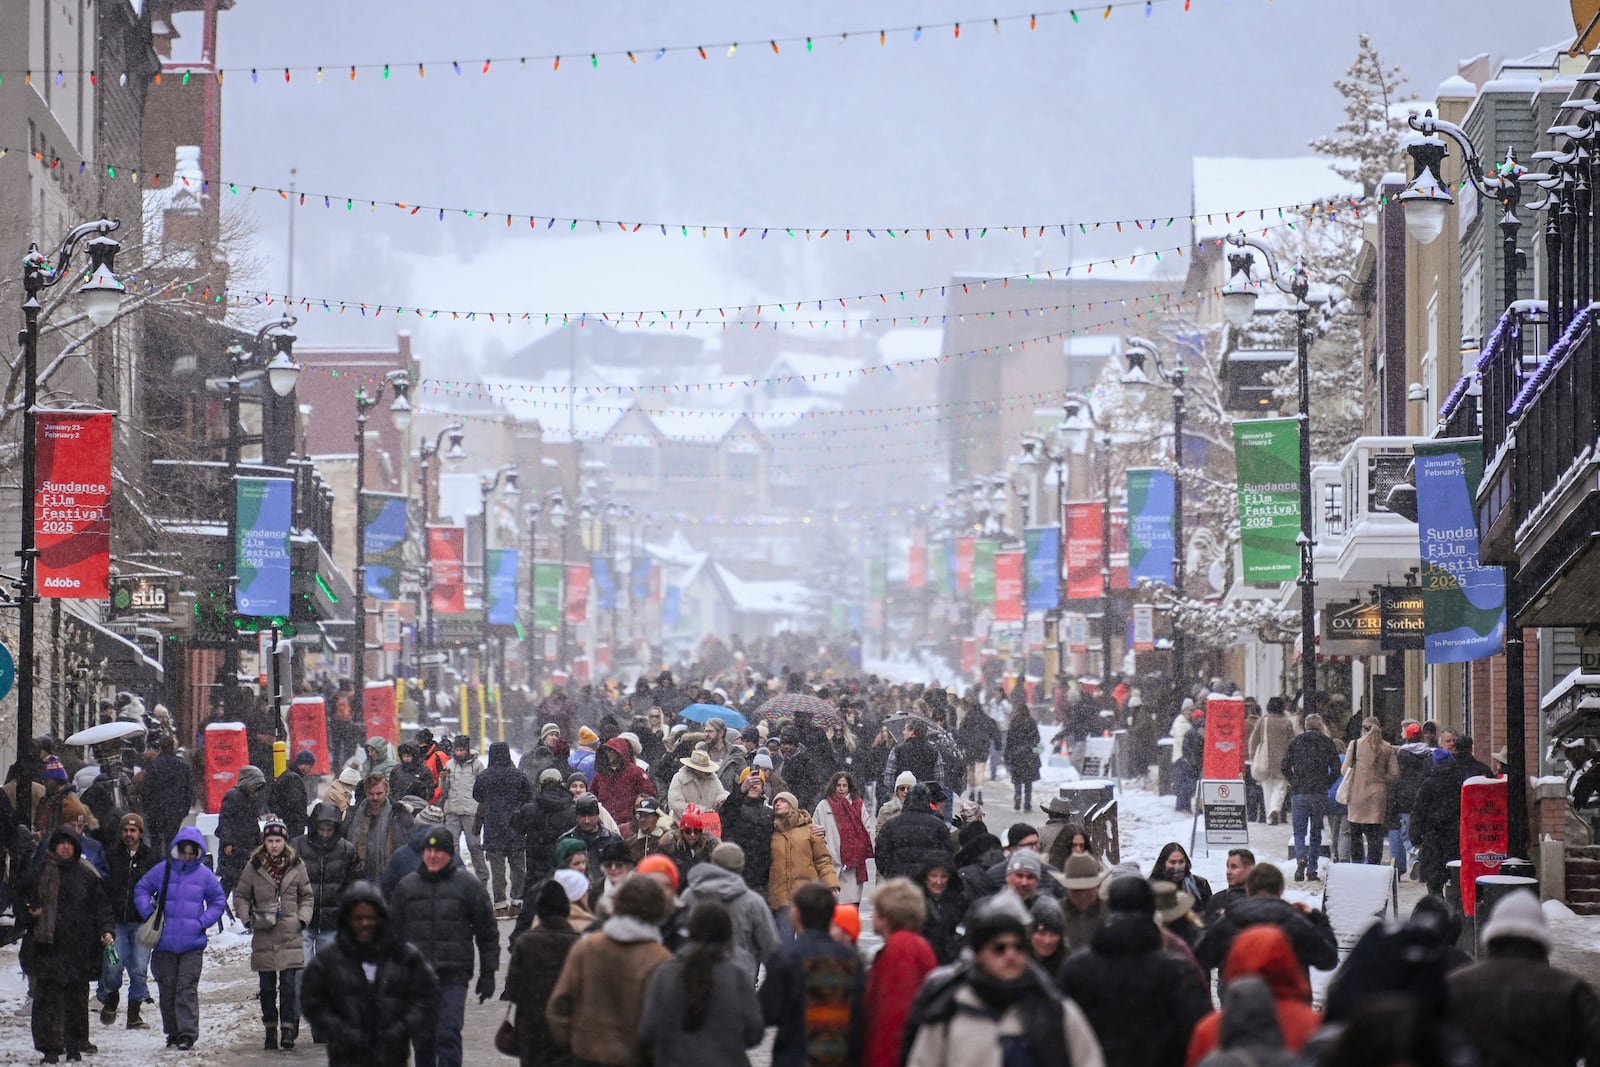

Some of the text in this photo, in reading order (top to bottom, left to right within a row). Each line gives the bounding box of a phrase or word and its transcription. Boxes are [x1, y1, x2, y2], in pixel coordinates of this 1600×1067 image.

[45, 424, 71, 432] January
[1241, 439, 1267, 447] February
[1424, 459, 1455, 469] January
[1425, 467, 1466, 477] February 2
[43, 480, 106, 493] Sundance
[1243, 481, 1298, 493] Sundance
[43, 494, 75, 506] Film
[1244, 493, 1273, 504] Film
[43, 507, 104, 519] Festival
[1245, 503, 1298, 516] Festival
[42, 521, 74, 532] 2025
[1246, 516, 1273, 527] 2025
[241, 527, 287, 538] Sundance
[241, 538, 265, 548] Film
[241, 547, 286, 558] Festival
[1428, 542, 1466, 556] Film
[241, 558, 264, 568] 2025
[44, 577, 81, 588] Adobe
[1429, 573, 1467, 589] 2025
[1442, 638, 1465, 647] Person
[1478, 834, 1501, 842] EVENT
